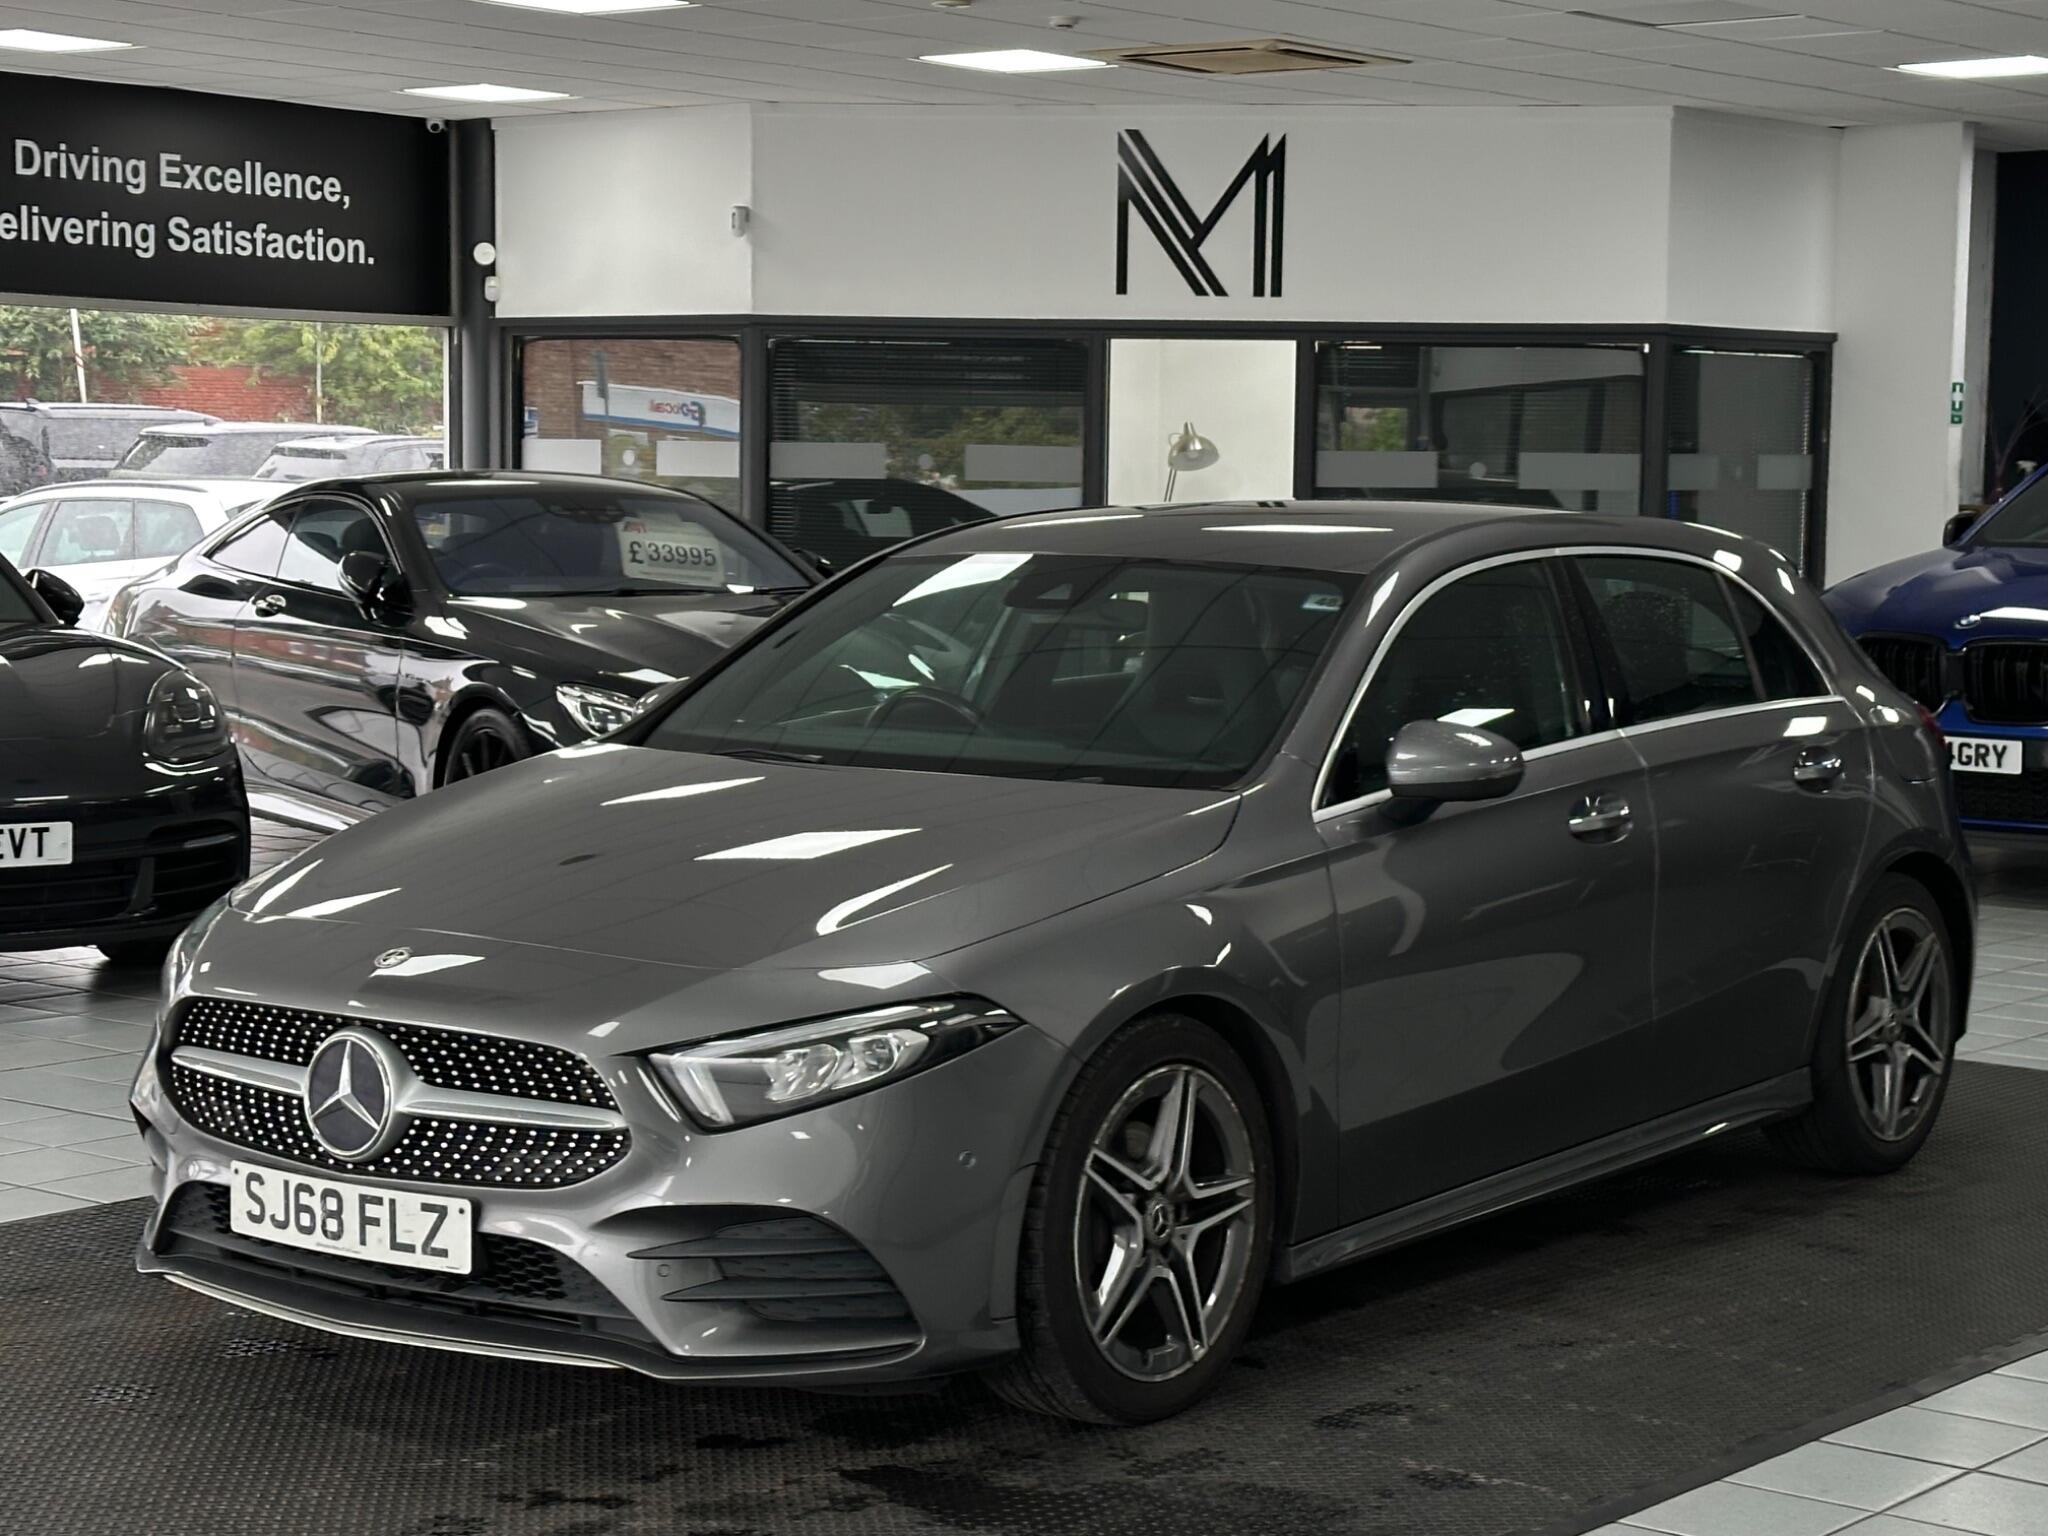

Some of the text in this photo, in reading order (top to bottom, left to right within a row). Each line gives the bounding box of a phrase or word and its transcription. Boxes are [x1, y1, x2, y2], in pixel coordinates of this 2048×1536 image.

[15, 139, 350, 209] Driving Excellence,
[167, 216, 374, 265] Satisfaction.
[0, 827, 50, 859] VT
[246, 1172, 448, 1258] SJ68 FLZ
